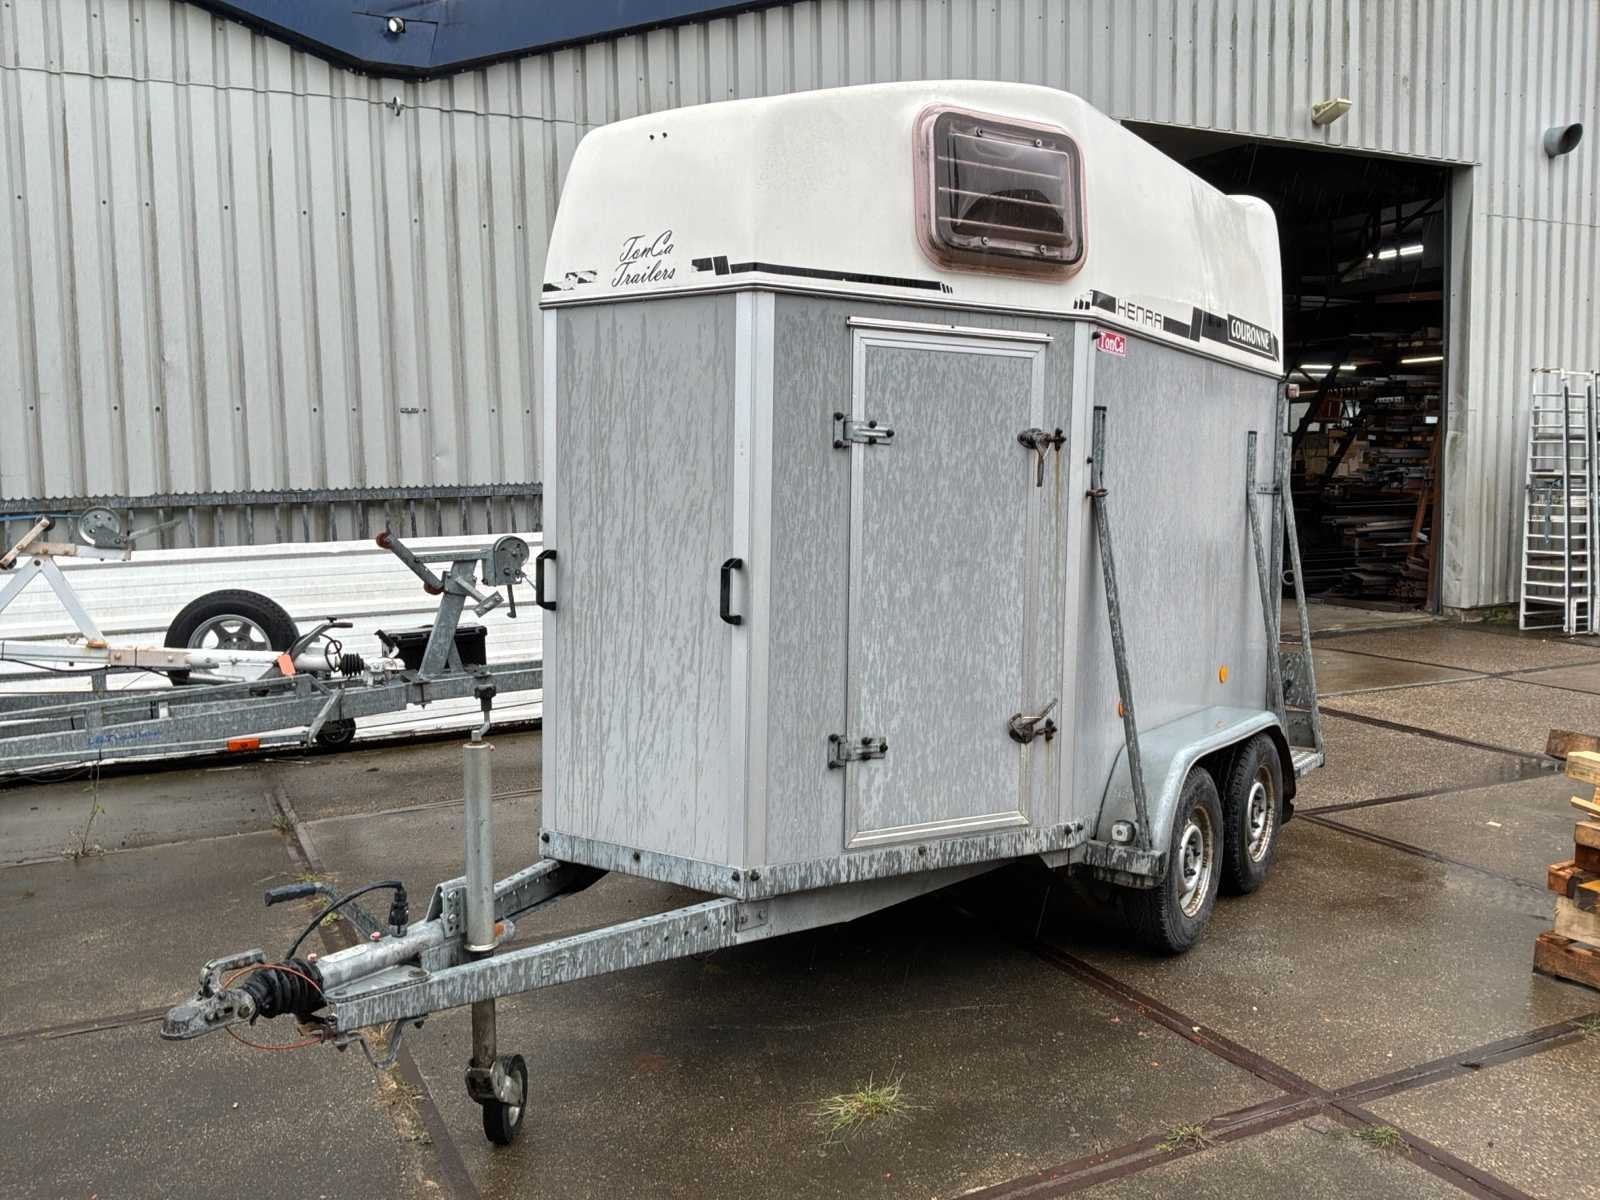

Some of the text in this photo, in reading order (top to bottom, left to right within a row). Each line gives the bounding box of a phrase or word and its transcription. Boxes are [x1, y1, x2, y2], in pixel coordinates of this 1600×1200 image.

[619, 229, 675, 262] TonCa
[611, 260, 676, 288] Trailers
[1116, 298, 1163, 330] HENRA
[1231, 319, 1271, 350] COURONNE
